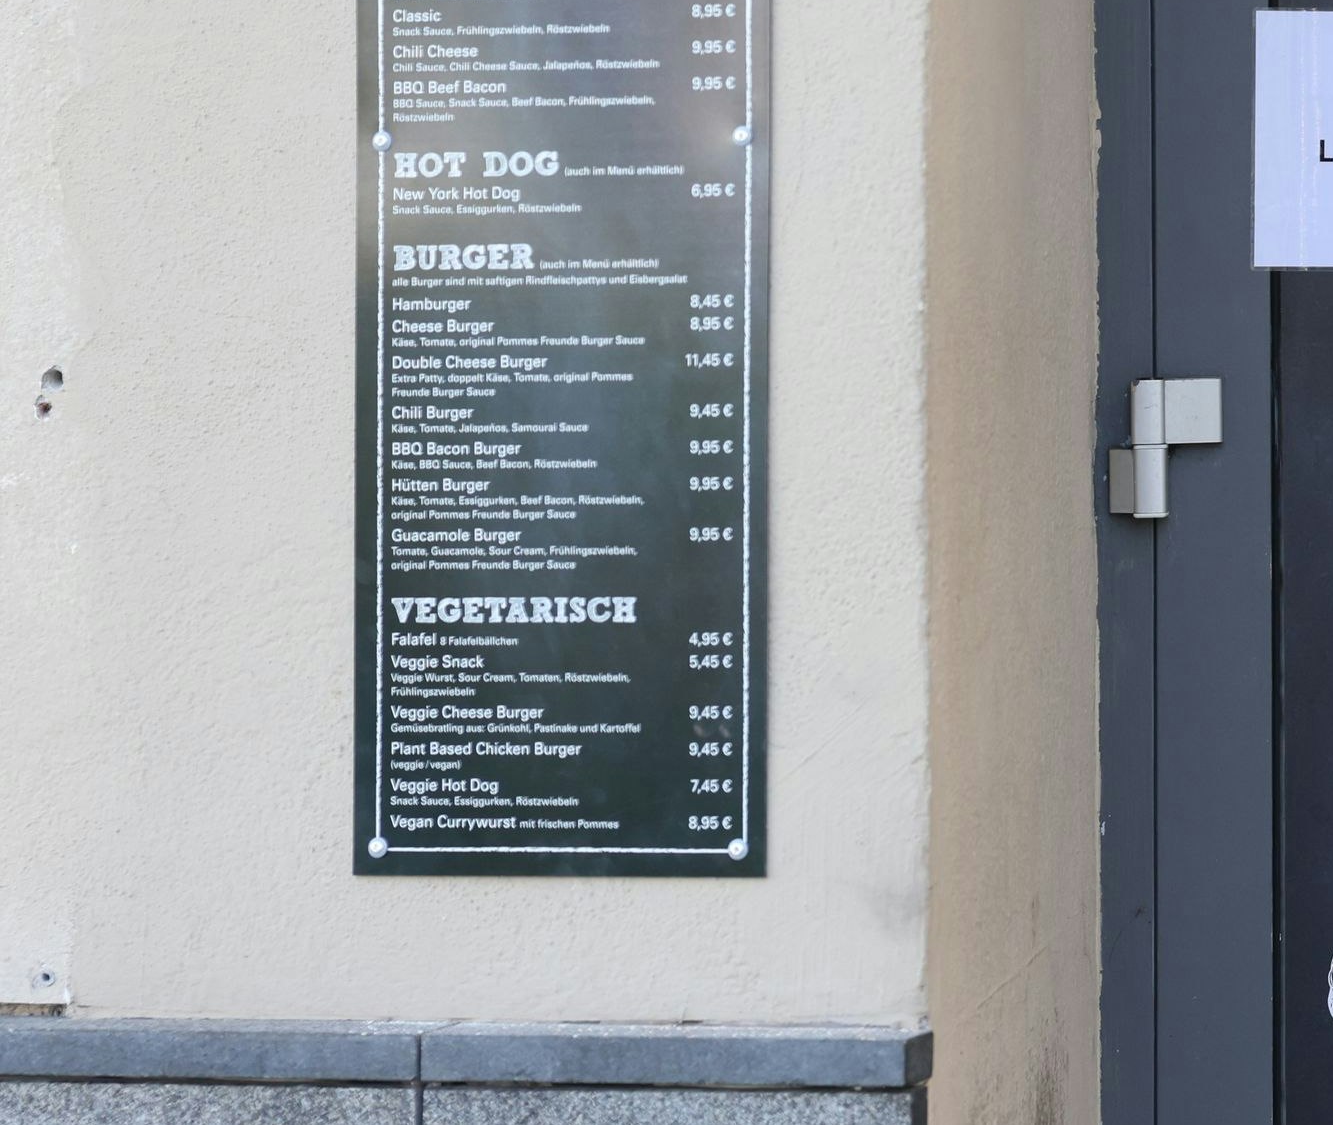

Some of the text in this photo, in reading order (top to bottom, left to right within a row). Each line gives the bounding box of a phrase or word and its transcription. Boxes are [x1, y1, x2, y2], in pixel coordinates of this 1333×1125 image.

[393, 150, 559, 178] HOT DOG
[393, 185, 520, 202] New York Hot Dog
[691, 183, 722, 198] 6,95
[393, 243, 535, 271] BURGER
[392, 296, 472, 313] Hamburger
[392, 354, 548, 371] Double Cheese Burger
[684, 352, 721, 369] 11,45
[390, 596, 637, 624] VEGETARISCH
[391, 631, 437, 646] Falafel
[390, 740, 582, 758] Plant Based Chicken Burger
[389, 814, 434, 831] Vegan
[436, 813, 517, 831] Currywurst
[688, 815, 720, 831] 8,95
